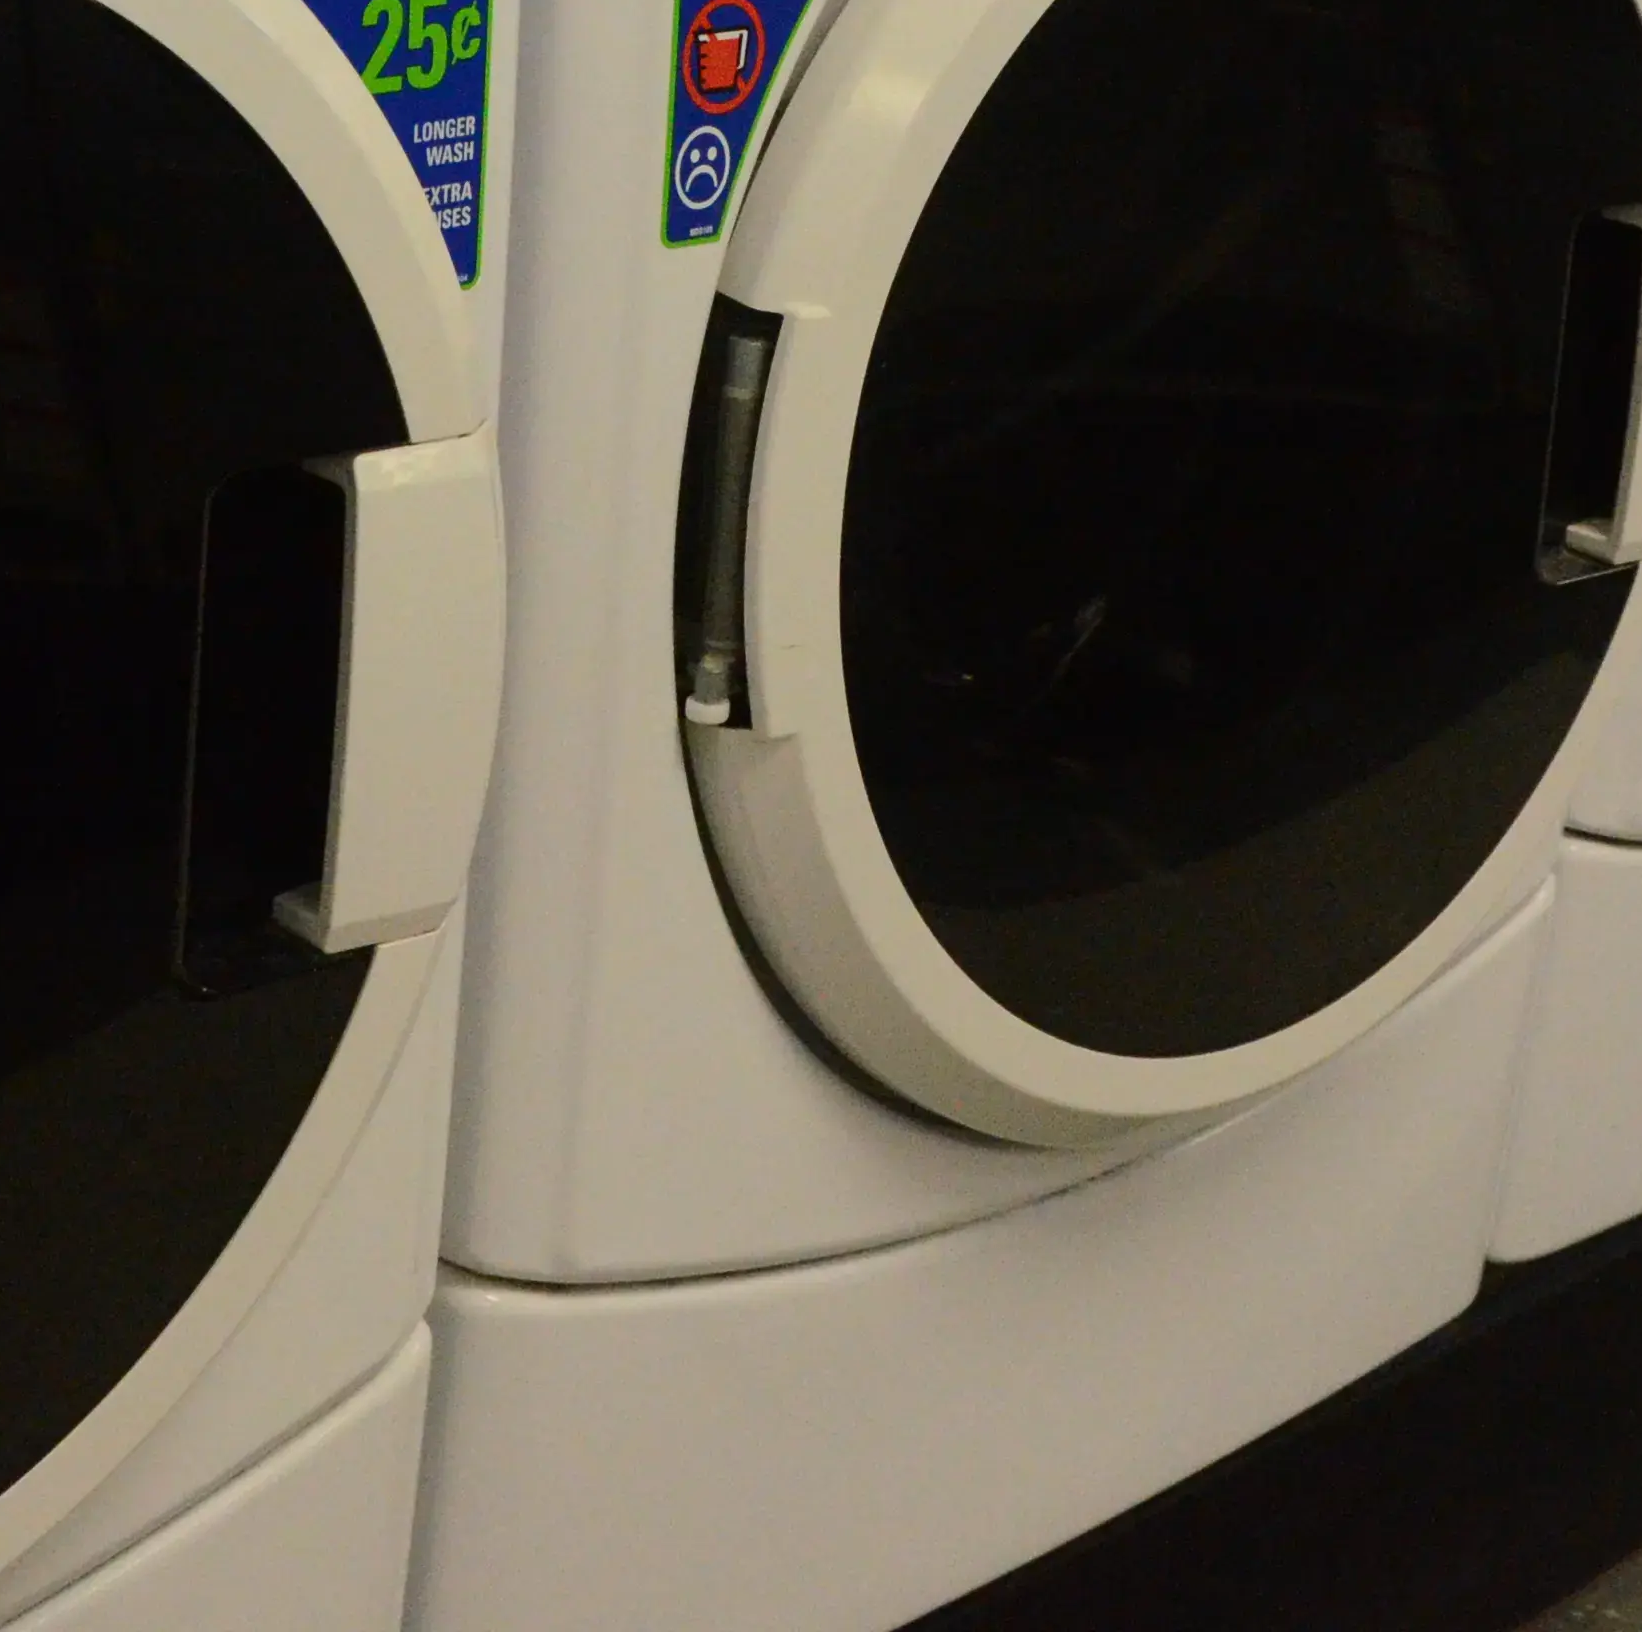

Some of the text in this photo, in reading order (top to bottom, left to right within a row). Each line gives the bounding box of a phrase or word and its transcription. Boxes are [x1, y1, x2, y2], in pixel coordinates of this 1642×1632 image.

[413, 115, 476, 144] LONGER
[425, 140, 475, 168] WASH
[436, 206, 471, 230] SES
